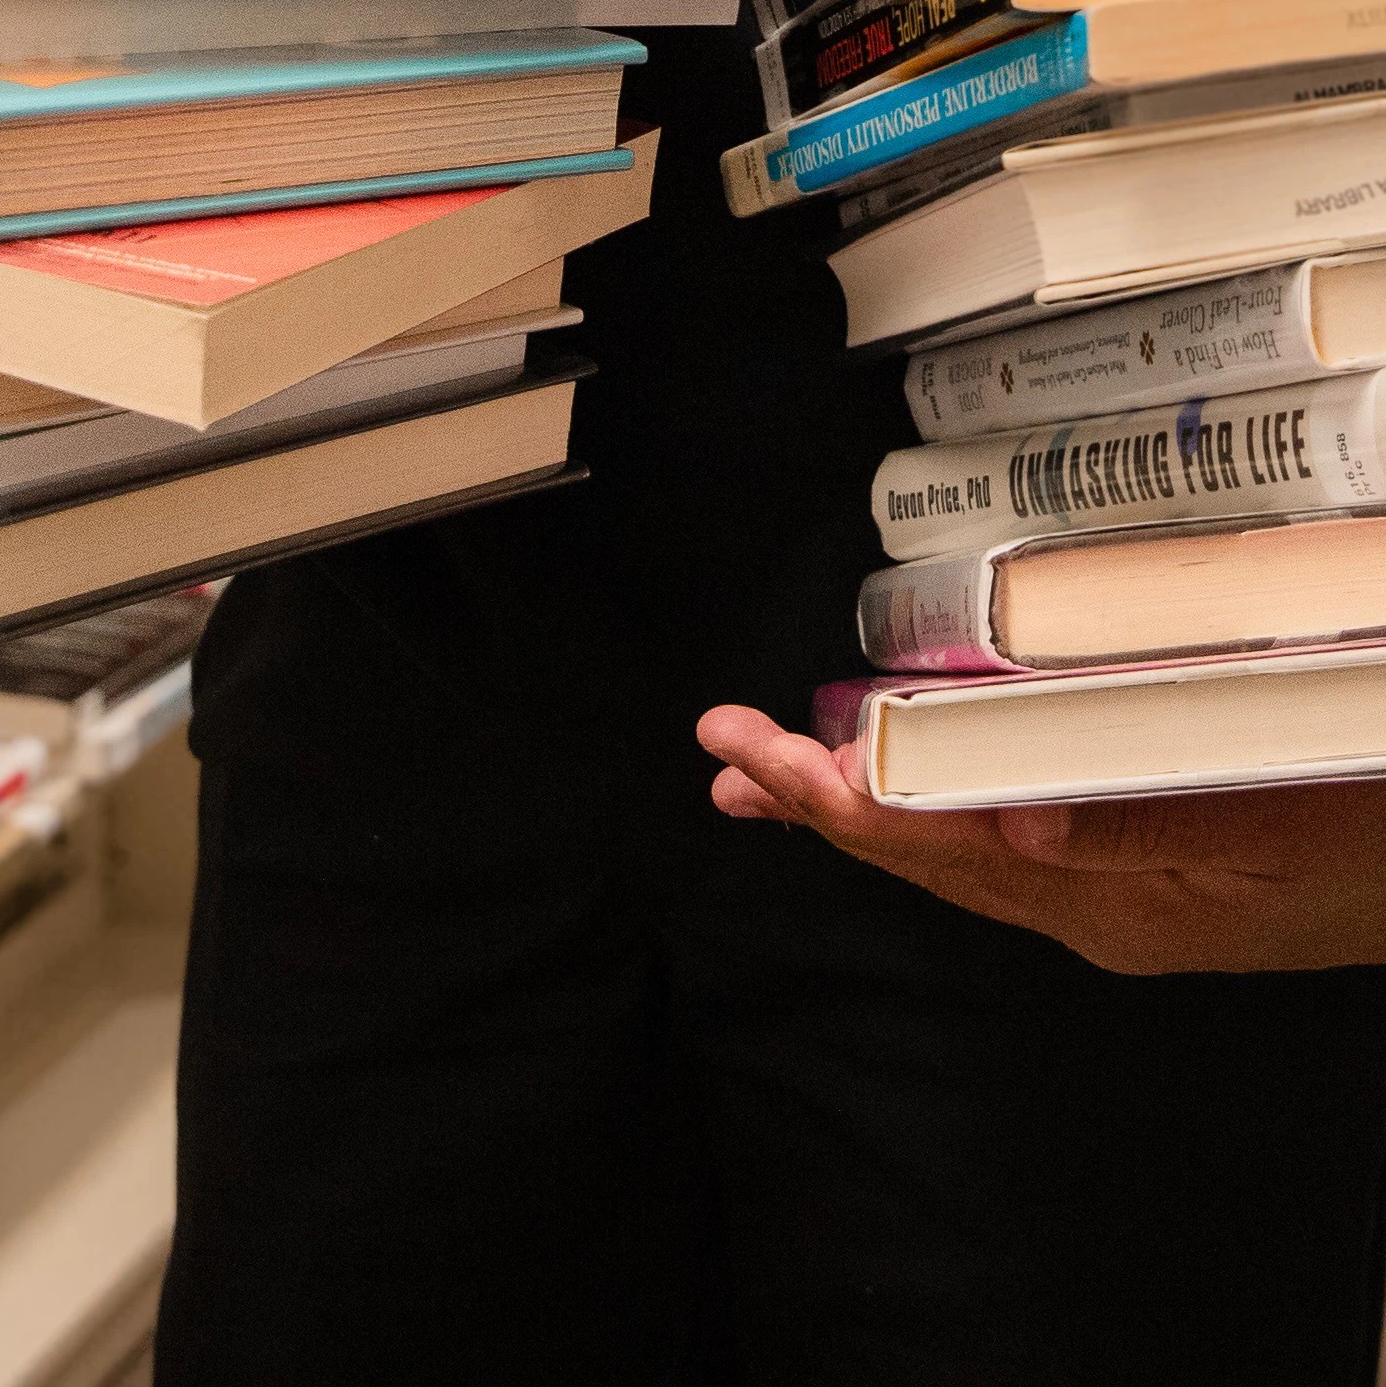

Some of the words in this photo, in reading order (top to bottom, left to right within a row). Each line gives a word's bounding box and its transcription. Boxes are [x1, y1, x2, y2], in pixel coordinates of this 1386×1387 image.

[863, 16, 895, 63] TRUE
[892, 0, 926, 47] HOPE,
[815, 31, 863, 89] FREEDOM
[943, 53, 1040, 119] BORDERLINE
[847, 95, 941, 158] PERSONALITY
[776, 130, 844, 179] DISORDER
[1294, 181, 1375, 218] LIBRARY
[1159, 303, 1205, 335] Clover
[1211, 284, 1283, 328] Four-Leaf
[1173, 349, 1182, 366] a
[1184, 339, 1225, 374] Find
[1222, 337, 1240, 356] to
[1244, 329, 1282, 359] How
[958, 383, 986, 414] JODI
[1010, 429, 1173, 519] UNMASKING
[1178, 420, 1236, 494] FOR
[1244, 408, 1313, 485] LIFE
[1354, 458, 1380, 498] Pric
[887, 485, 923, 522] Devon
[927, 480, 963, 519] Price,
[965, 473, 992, 511] PhD
